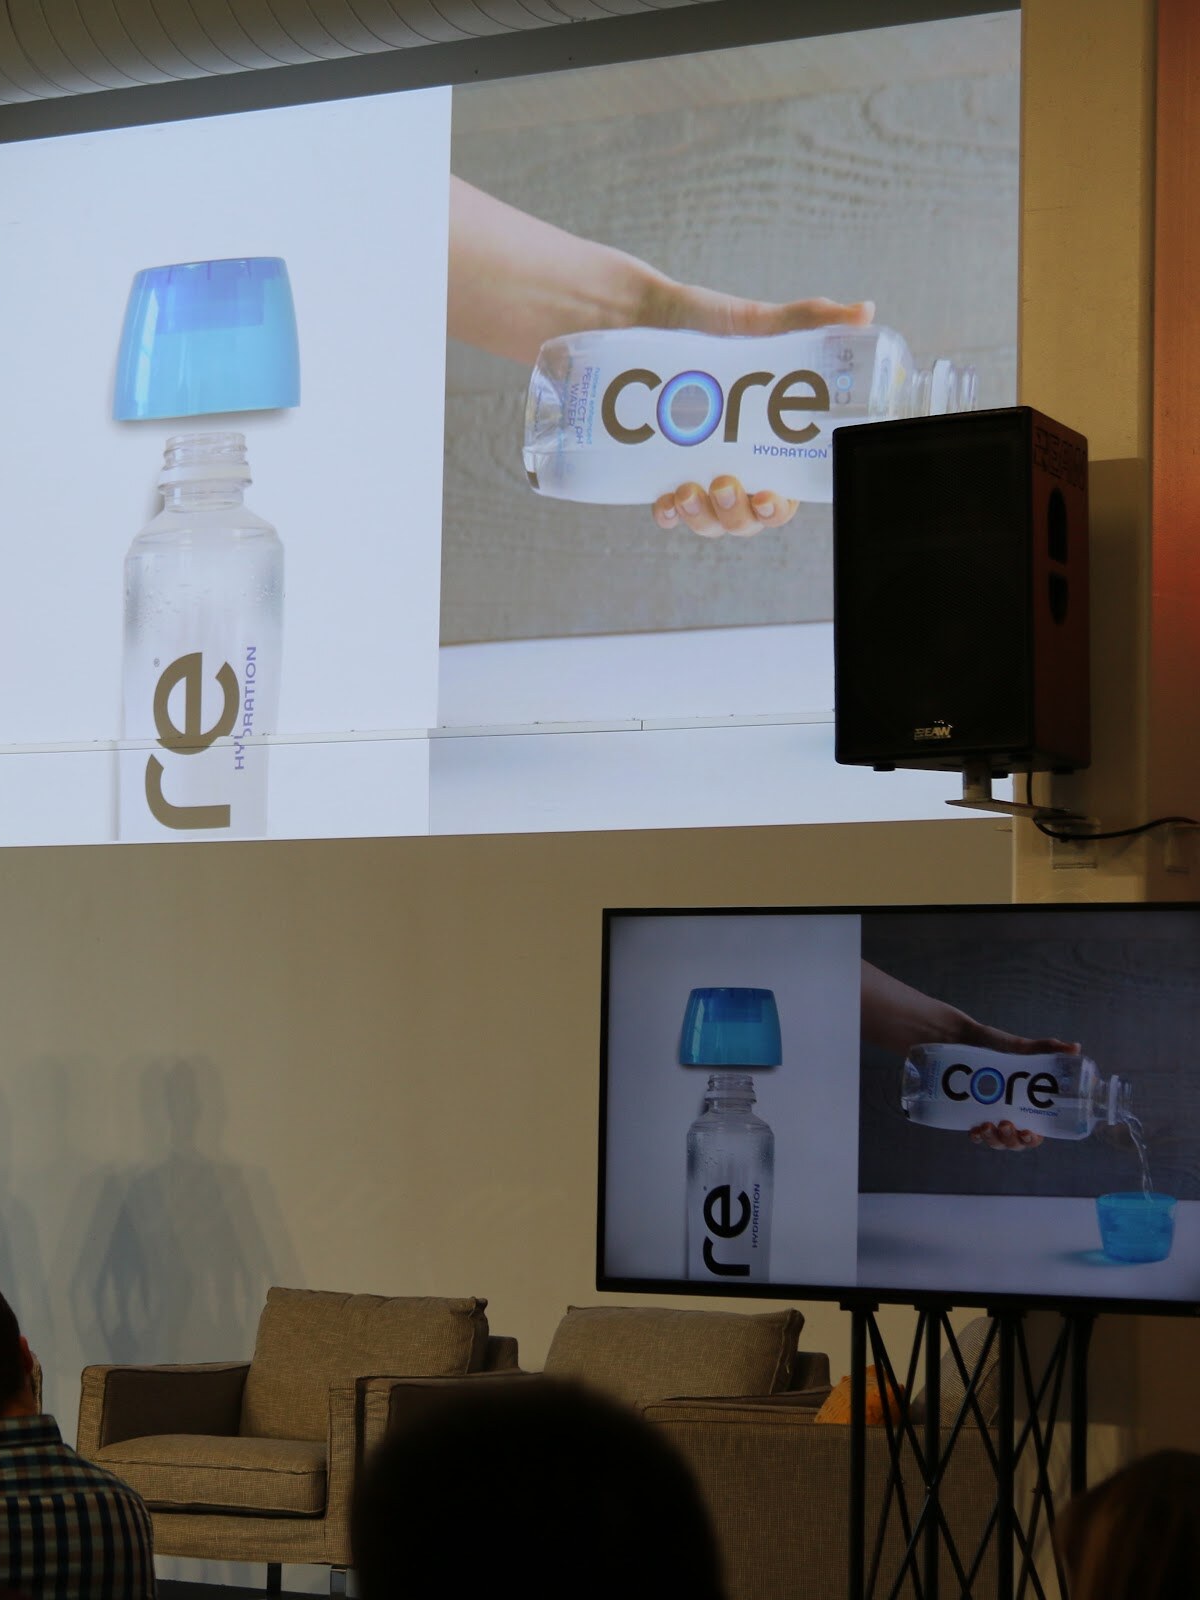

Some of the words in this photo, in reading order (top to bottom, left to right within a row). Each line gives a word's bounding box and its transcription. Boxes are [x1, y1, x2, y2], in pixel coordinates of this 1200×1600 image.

[567, 383, 580, 427] WATER
[576, 366, 593, 423] PERFECT
[601, 368, 830, 447] core
[753, 445, 828, 459] HYDRATION
[234, 646, 257, 770] HYDRATION
[942, 1064, 1059, 1109] core
[1020, 1106, 1059, 1117] HYDRATION
[752, 1183, 761, 1249] HYDRATION
